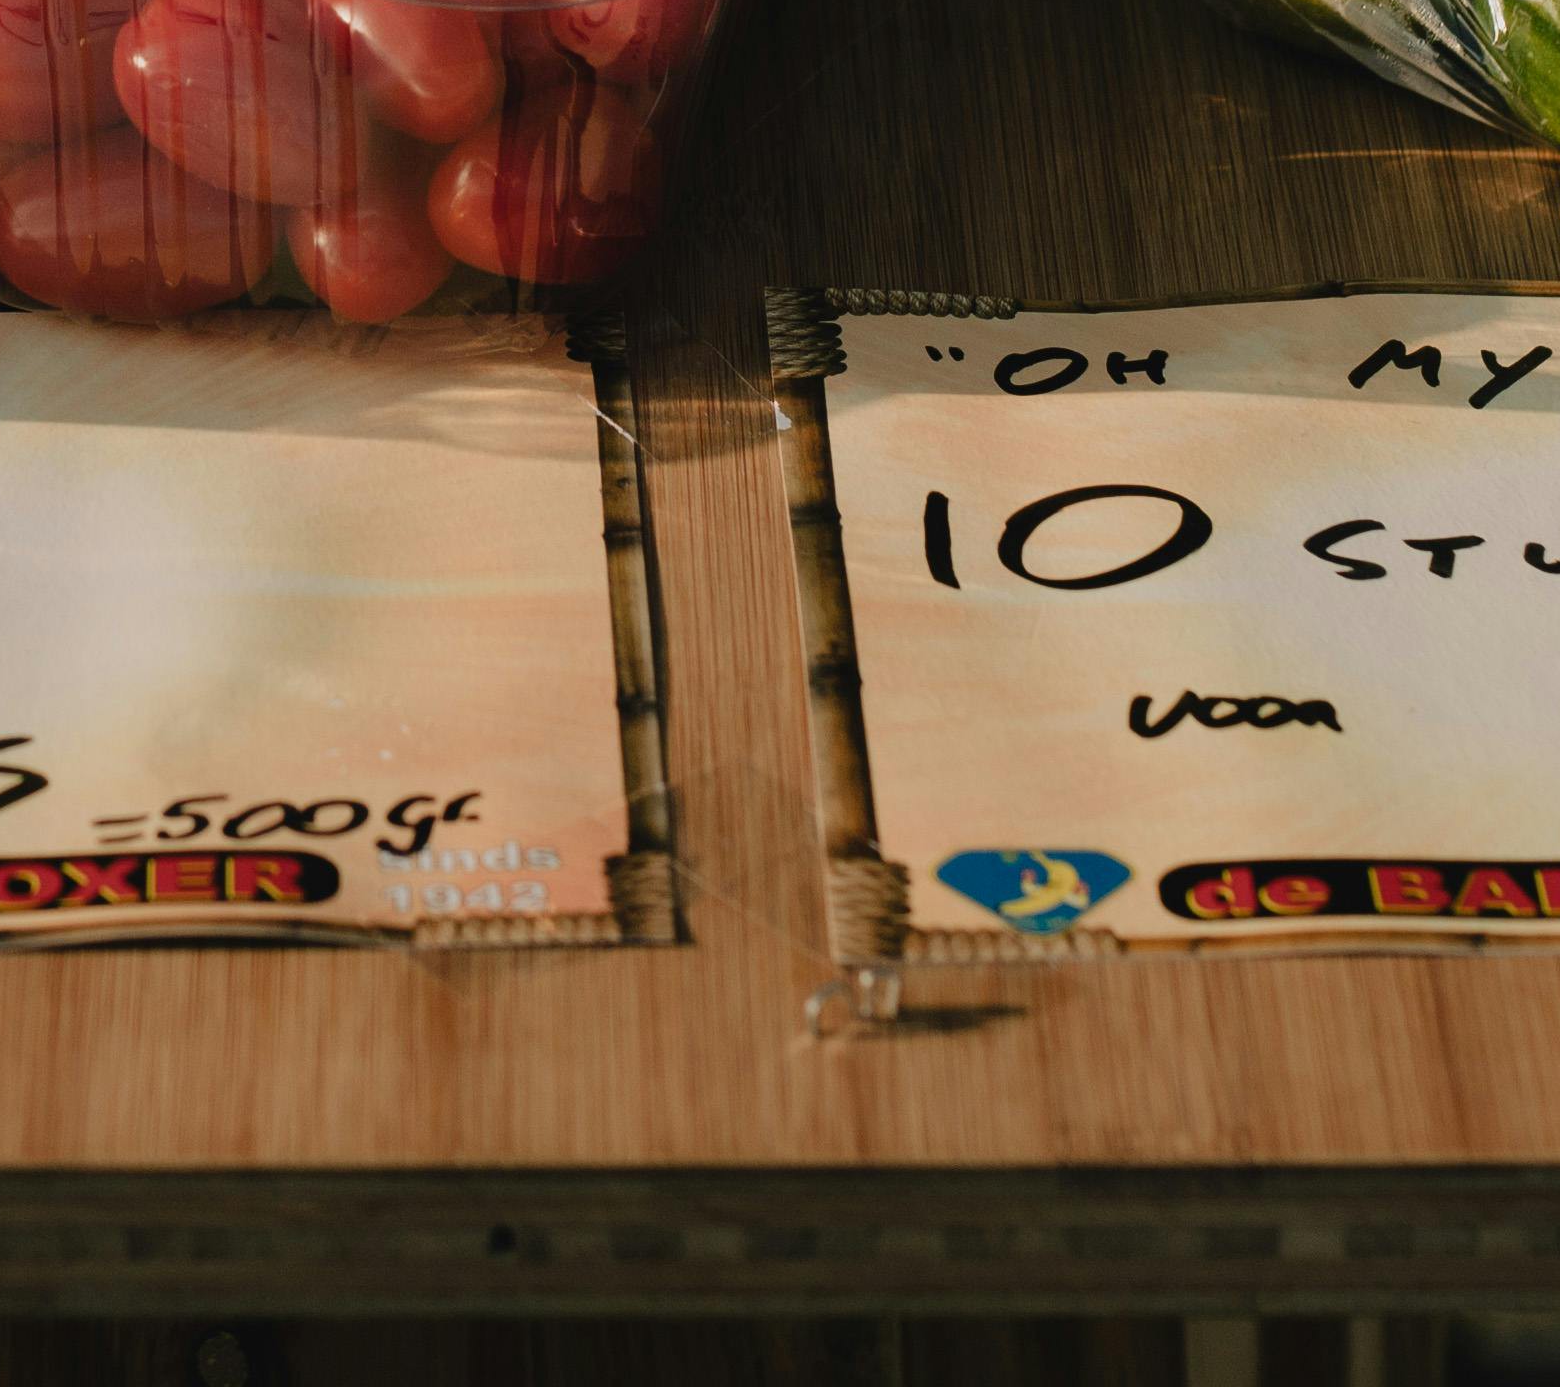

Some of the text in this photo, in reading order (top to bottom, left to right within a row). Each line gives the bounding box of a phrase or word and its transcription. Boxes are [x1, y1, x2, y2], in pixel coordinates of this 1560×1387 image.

[1348, 339, 1553, 409] MY
[923, 484, 1214, 591] 10
[382, 880, 551, 913] 1942
[1187, 868, 1332, 920] de
